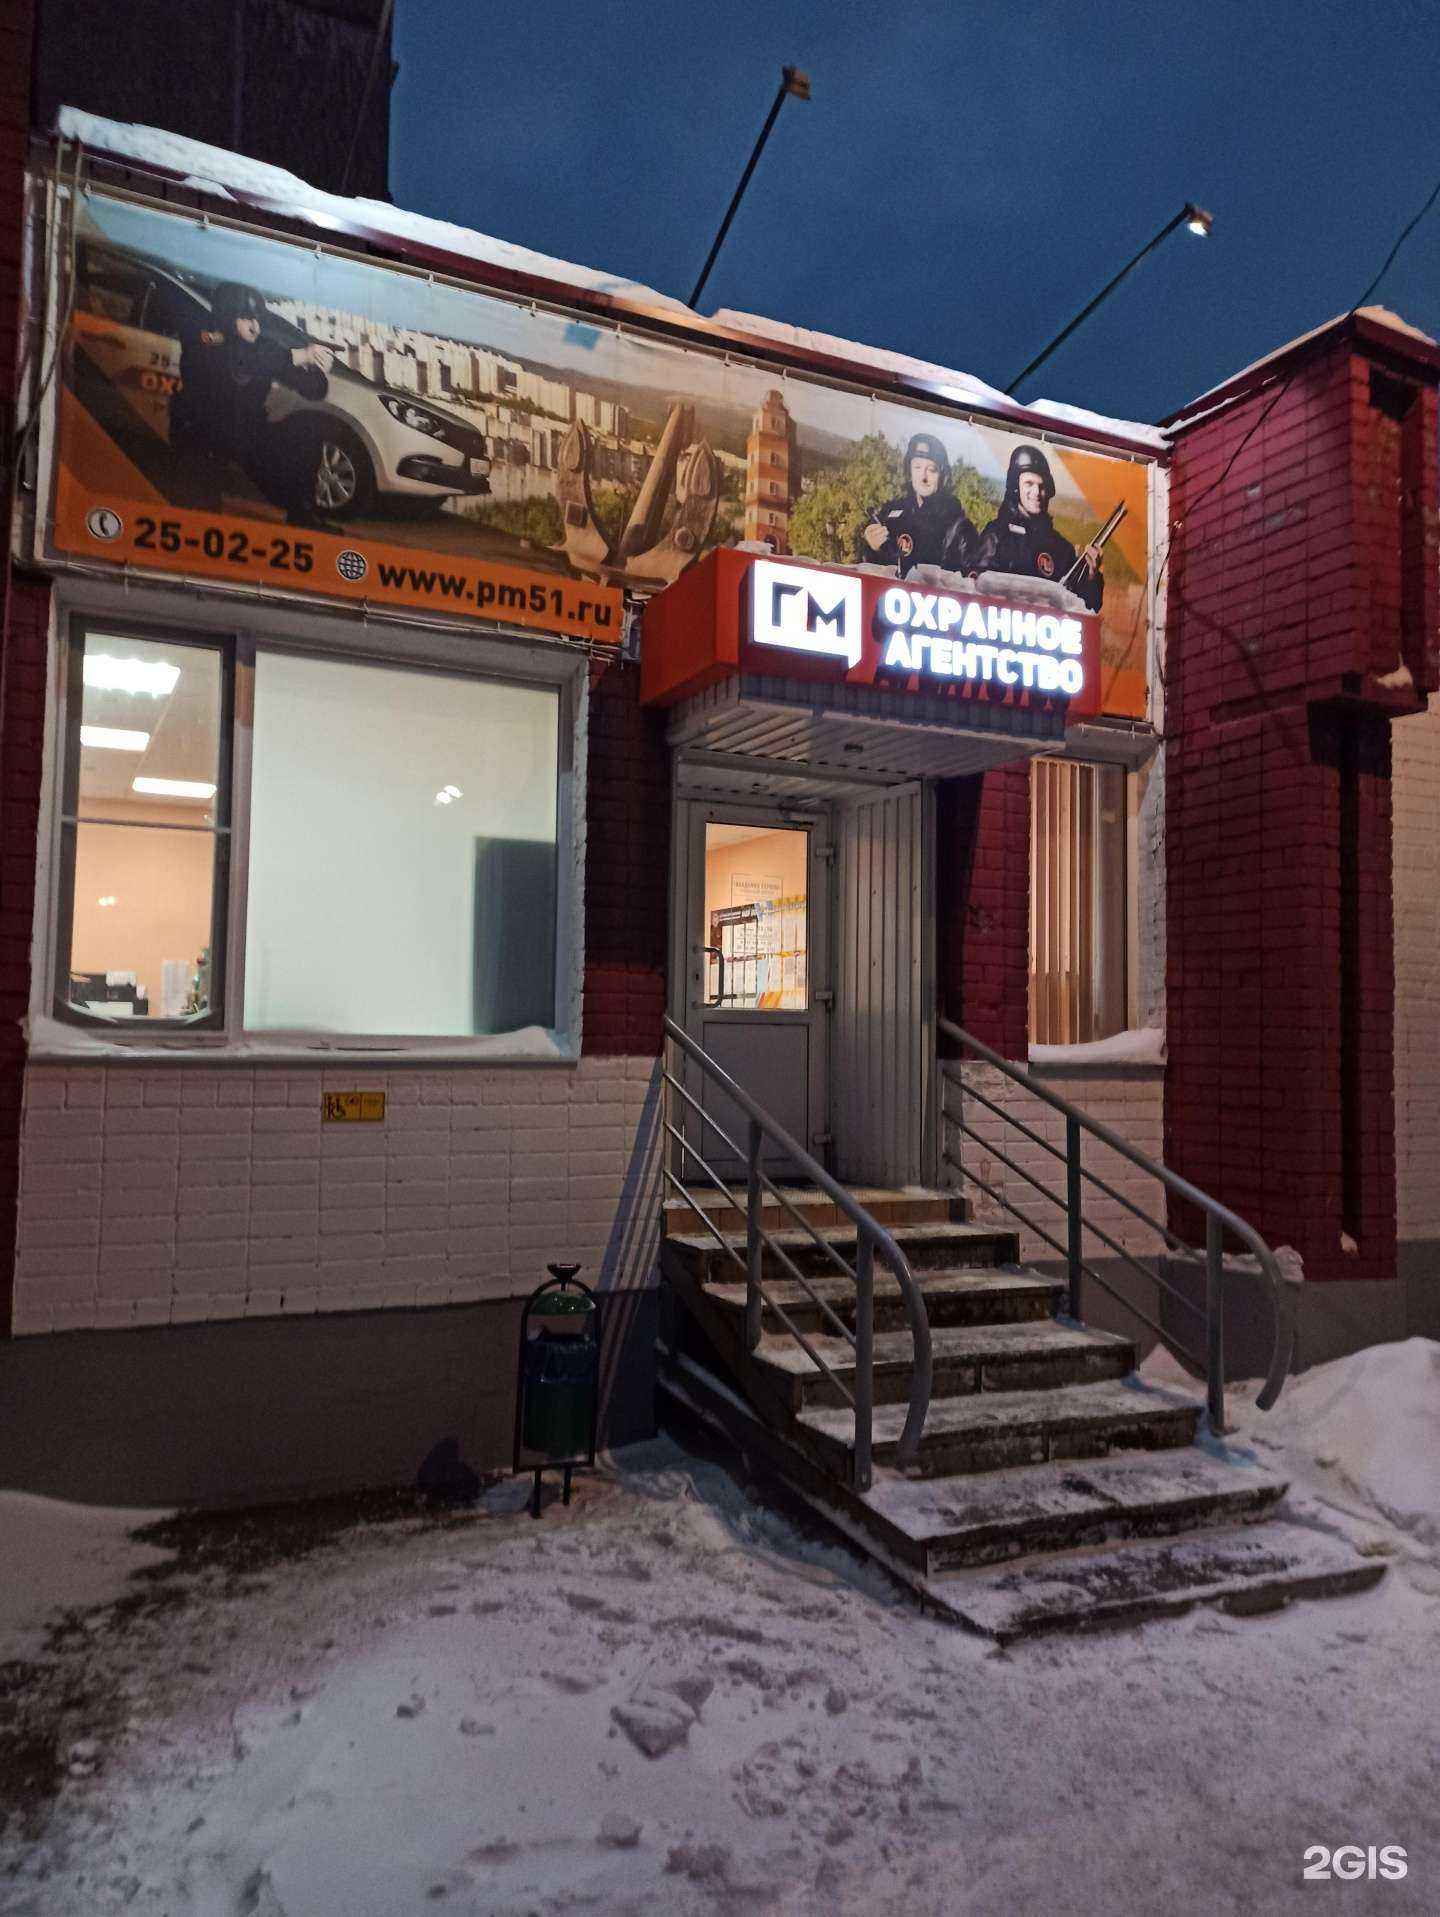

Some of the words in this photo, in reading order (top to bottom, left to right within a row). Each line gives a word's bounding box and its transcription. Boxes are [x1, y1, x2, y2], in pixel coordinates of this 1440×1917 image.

[134, 517, 313, 572] 25-02-25
[378, 563, 611, 626] www.pm51.ru
[884, 587, 1083, 655] ОХРАННОЕ
[884, 630, 1084, 694] АГЕНТСТВО
